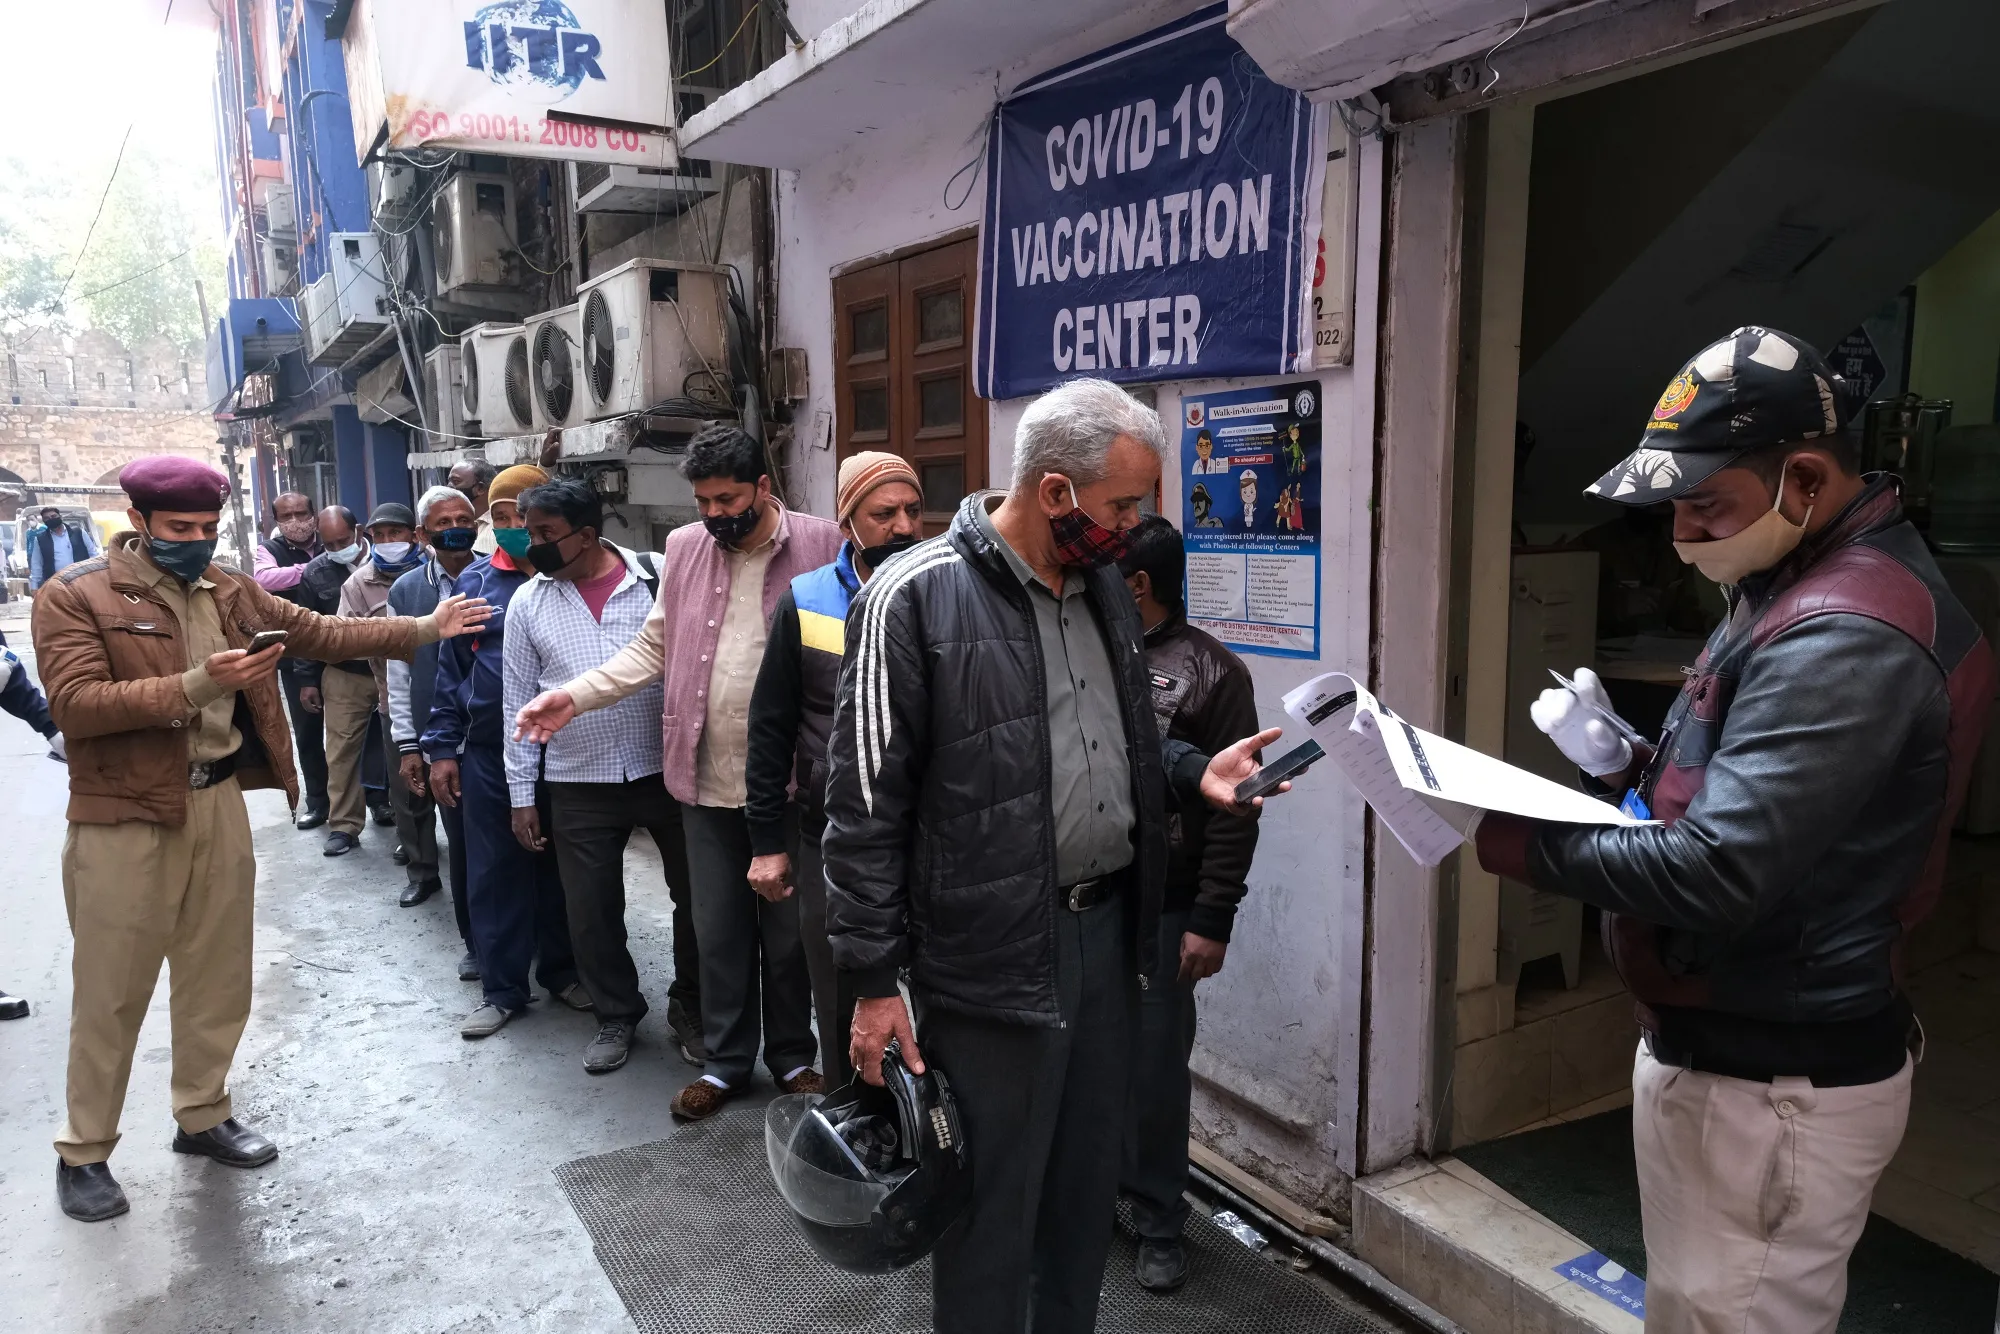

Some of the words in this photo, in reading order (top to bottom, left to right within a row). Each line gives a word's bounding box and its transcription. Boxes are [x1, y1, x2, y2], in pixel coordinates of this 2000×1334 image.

[463, 20, 607, 80] IITR
[460, 113, 530, 142] 9001:
[538, 118, 598, 149] 2008
[605, 127, 646, 152] CO.
[1045, 76, 1224, 192] COVID-19
[1011, 173, 1272, 288] VACCINATION
[1053, 294, 1201, 372] CENTER
[1213, 403, 1284, 417] Walk-in-Vaccination
[1193, 534, 1203, 542] you
[1214, 532, 1242, 542] registered
[1256, 533, 1277, 542] please
[1296, 533, 1314, 543] along
[1199, 541, 1212, 549] with
[1245, 543, 1274, 552] following
[1275, 543, 1300, 551] Centers
[1219, 621, 1228, 629] THE
[1228, 622, 1248, 631] DISTRICT
